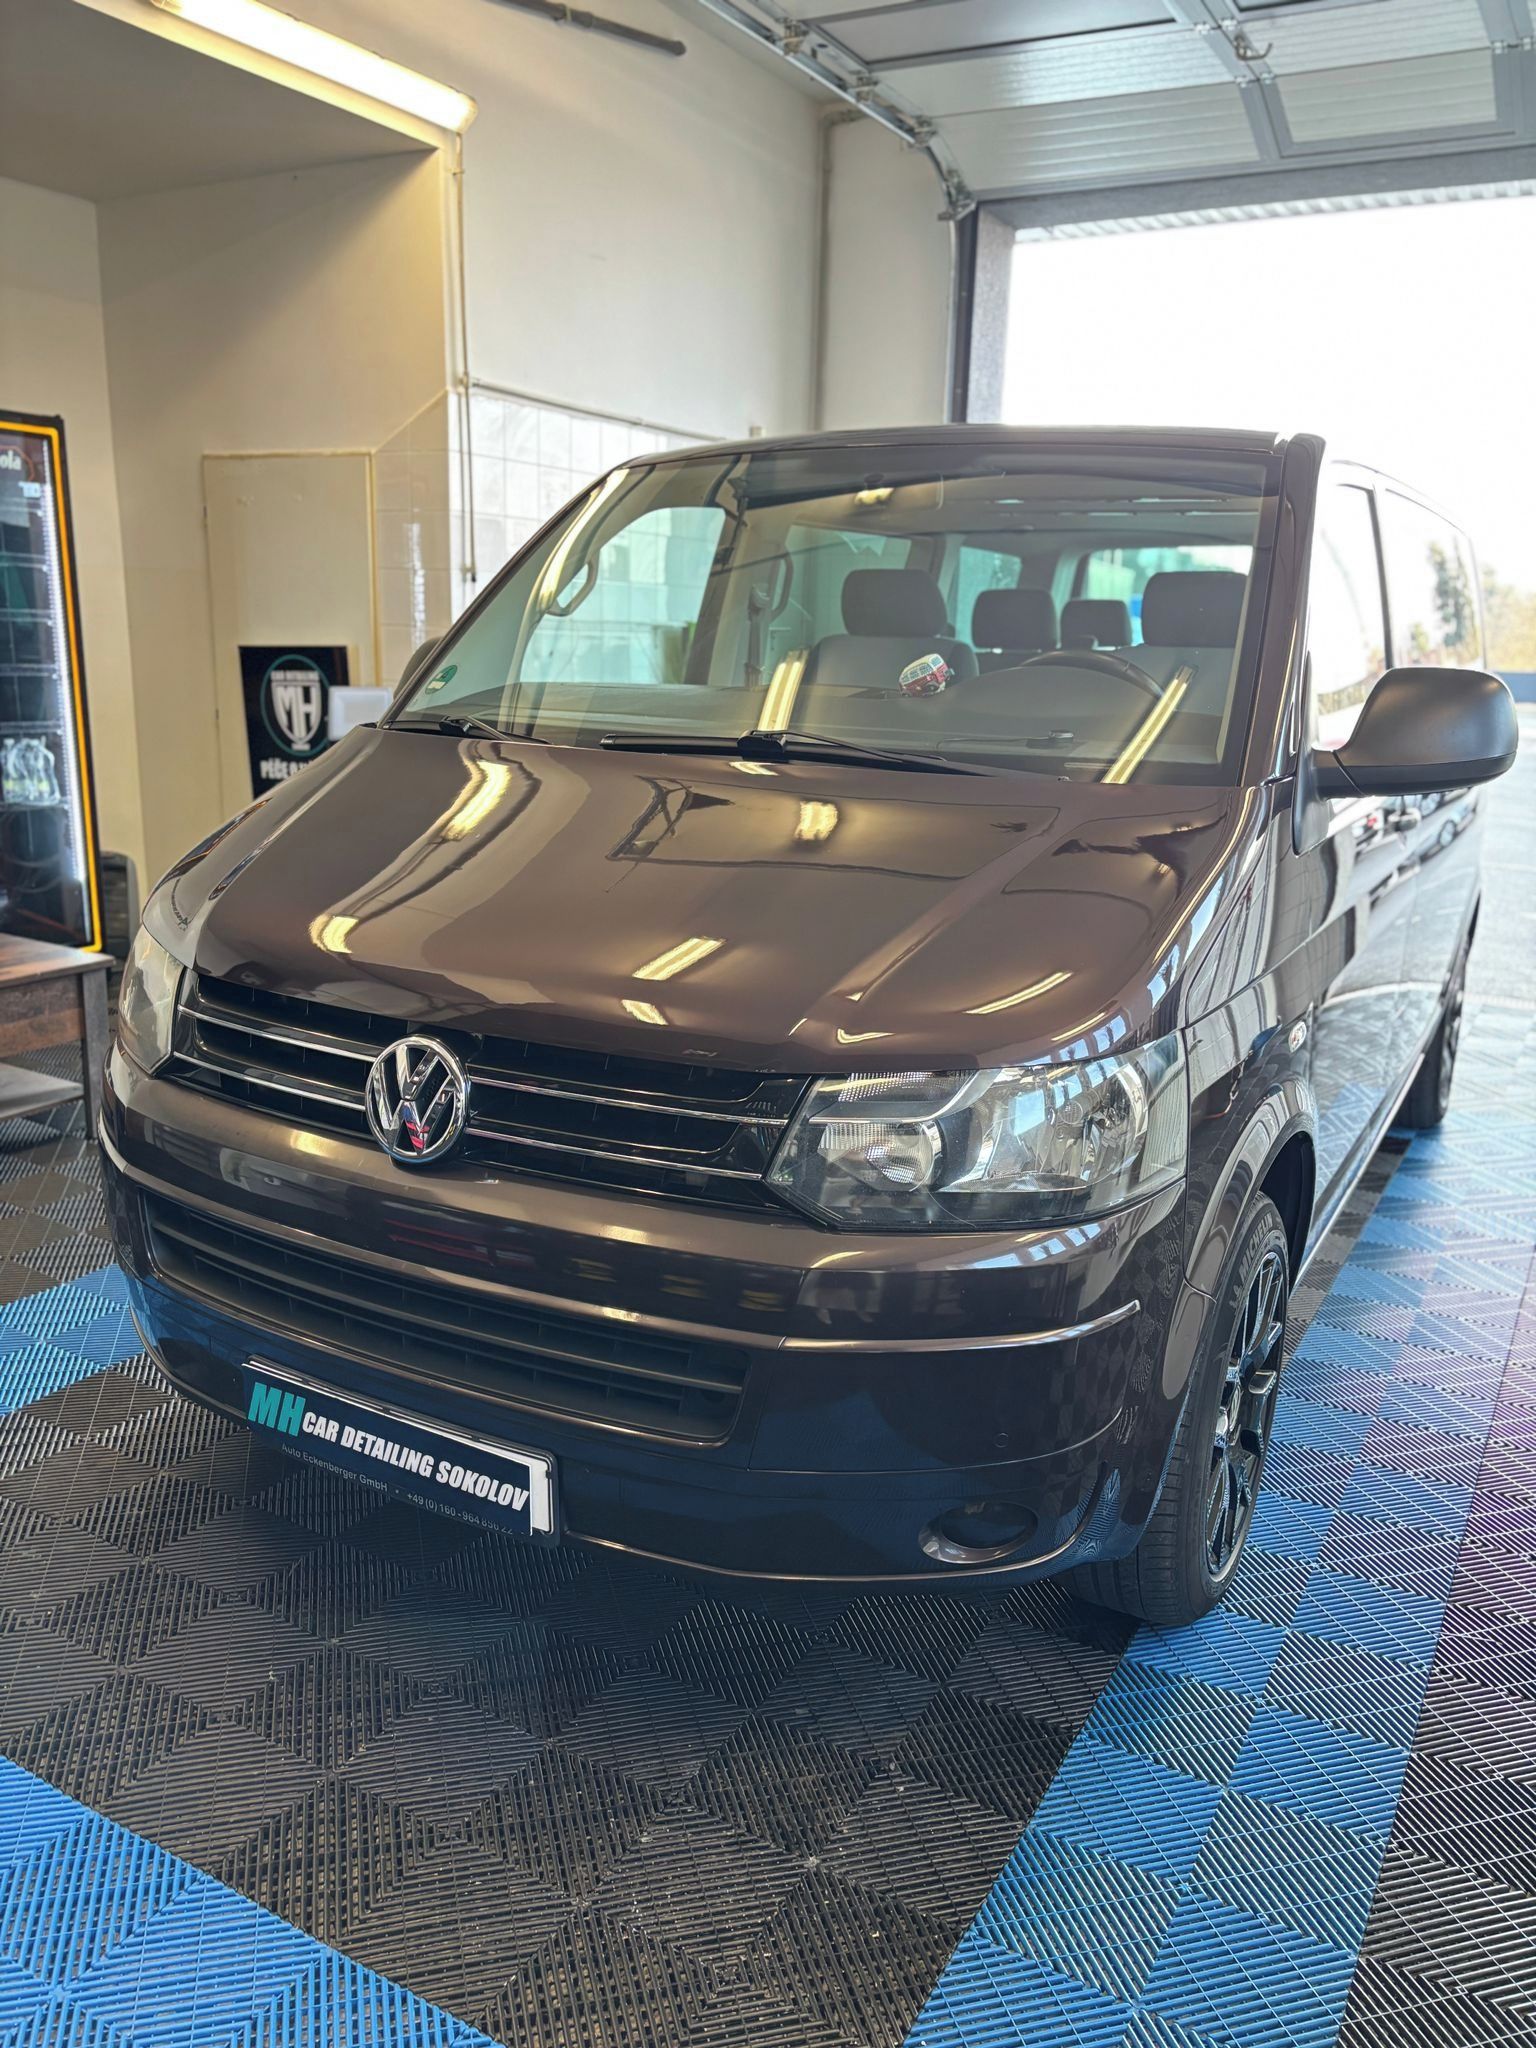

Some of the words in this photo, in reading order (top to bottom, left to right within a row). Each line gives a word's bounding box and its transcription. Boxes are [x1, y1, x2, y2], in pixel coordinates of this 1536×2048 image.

[273, 684, 320, 739] MH
[1238, 1212, 1274, 1281] MICHELIN
[248, 1381, 306, 1437] MH
[302, 1411, 340, 1443] CAR
[340, 1425, 435, 1478] DETAILING
[435, 1461, 530, 1512] SOKOLOV
[282, 1443, 301, 1458] Auto
[302, 1451, 358, 1480] Eckenberger
[359, 1475, 388, 1492] GmbH
